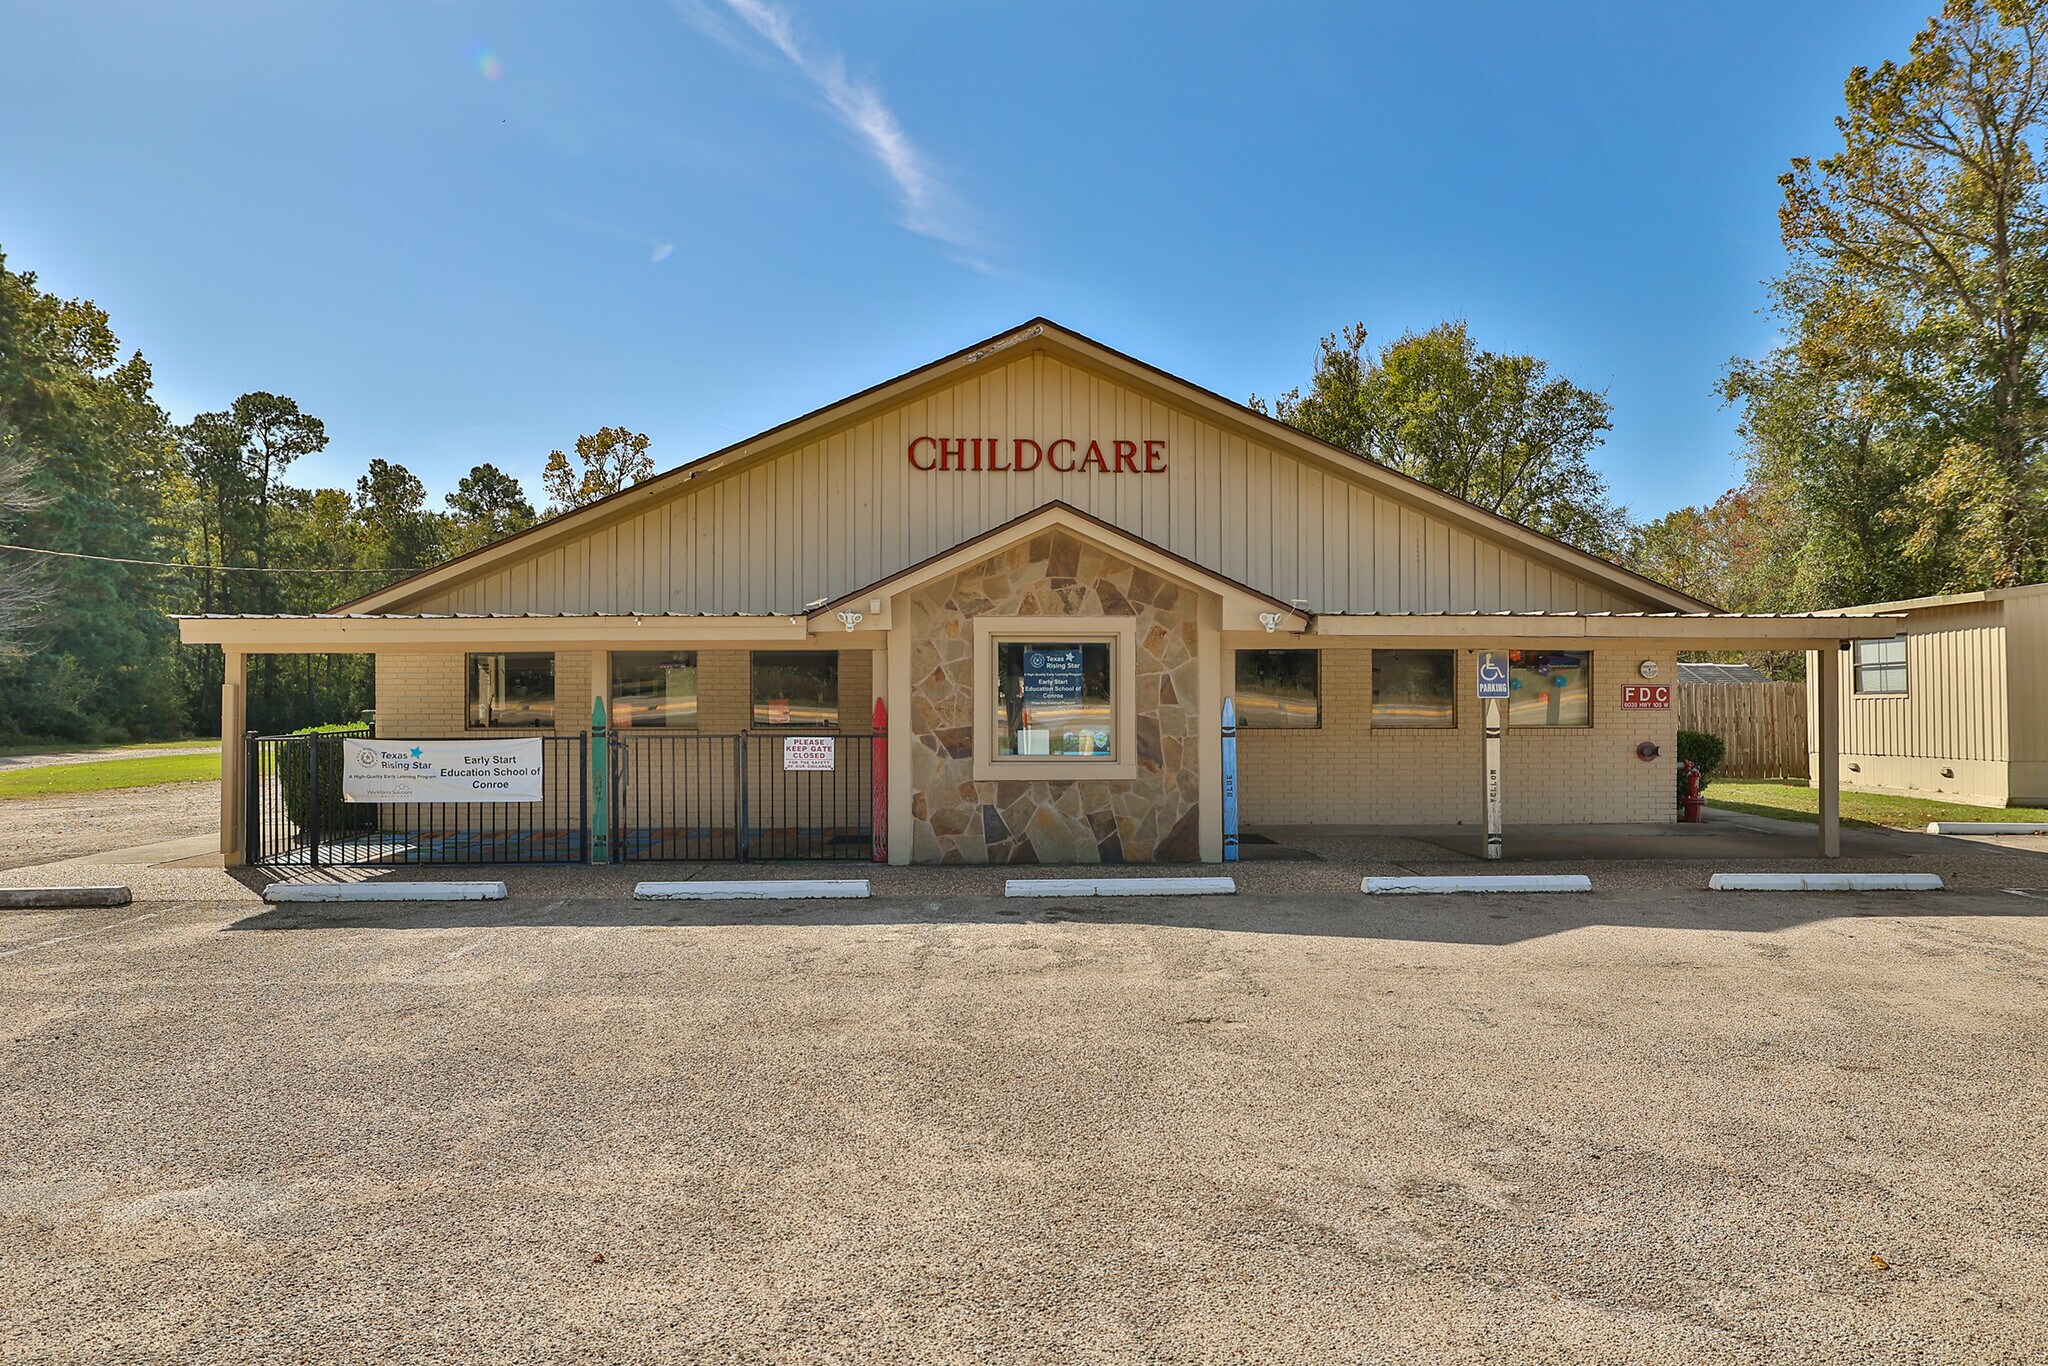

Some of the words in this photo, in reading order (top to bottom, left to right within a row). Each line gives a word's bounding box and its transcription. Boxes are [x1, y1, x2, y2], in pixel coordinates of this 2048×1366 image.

[908, 436, 1168, 473] CHILDCARE
[1479, 683, 1507, 692] PARKING
[381, 751, 408, 760] Texas
[464, 756, 490, 766] Early
[492, 755, 517, 764] Start
[381, 761, 410, 771] Rising
[412, 761, 432, 769] Star
[440, 768, 491, 777] Education
[493, 767, 528, 776] School
[530, 767, 541, 776] of
[472, 780, 509, 789] Conroe
[1489, 769, 1497, 803] YELLOW
